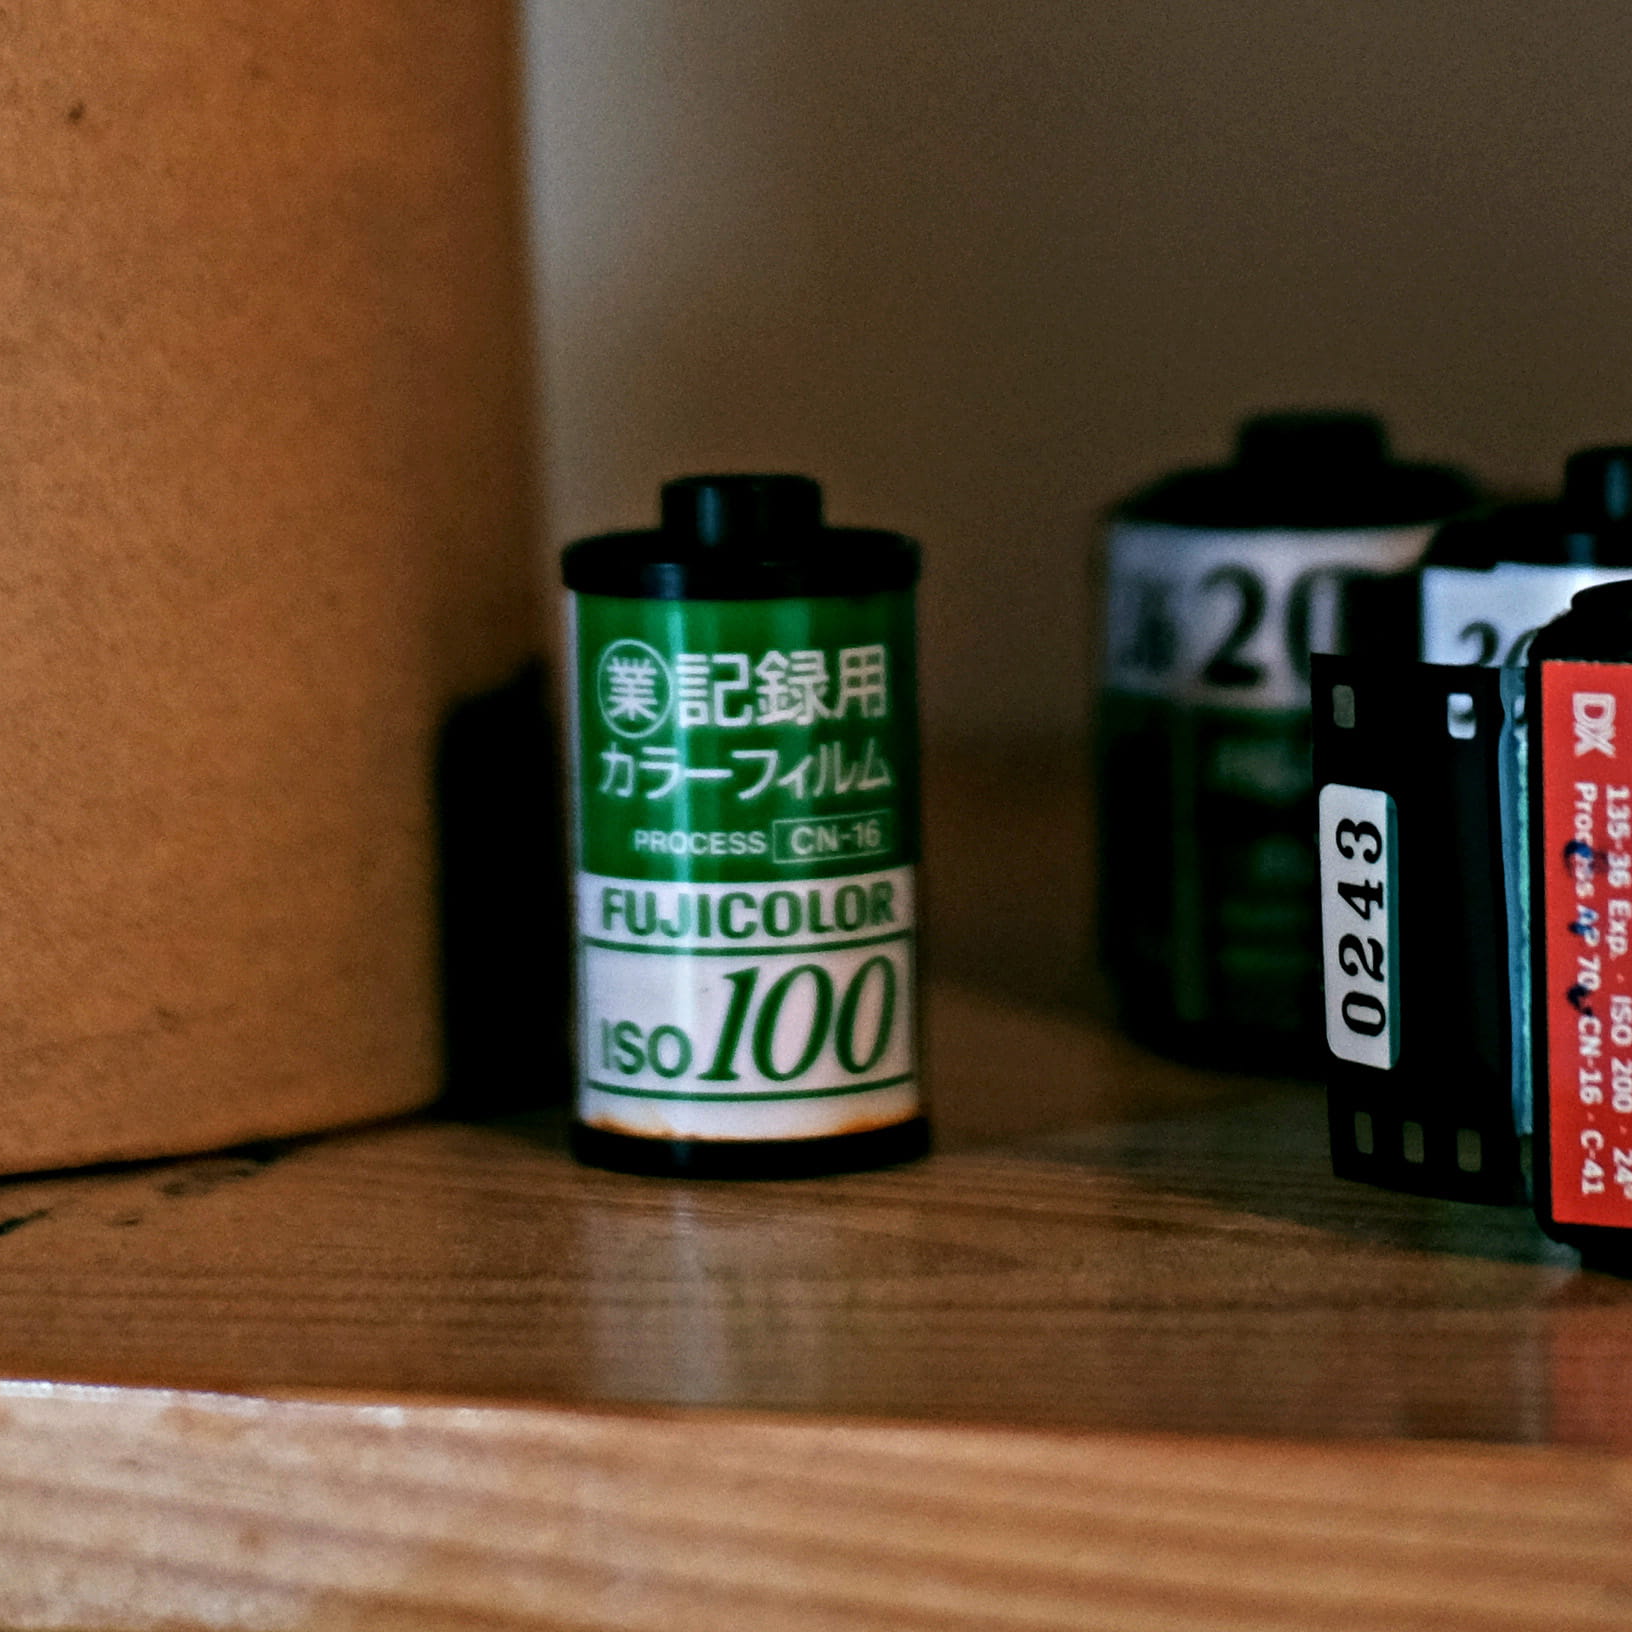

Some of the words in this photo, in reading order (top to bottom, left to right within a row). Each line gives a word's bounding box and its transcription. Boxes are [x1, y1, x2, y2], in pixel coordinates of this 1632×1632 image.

[1572, 692, 1616, 758] DX
[598, 738, 891, 800] カラーフィルム
[633, 829, 767, 856] PROCESS
[790, 818, 882, 856] CN-16
[1606, 784, 1632, 889] 135-36
[600, 880, 895, 939] FUJICOLOR
[1335, 817, 1386, 1039] 0243
[1577, 953, 1602, 992] 70
[600, 1018, 693, 1079] ISO
[695, 954, 897, 1082] 100
[1578, 1015, 1604, 1105] CN-16
[1580, 1129, 1605, 1196] C-41
